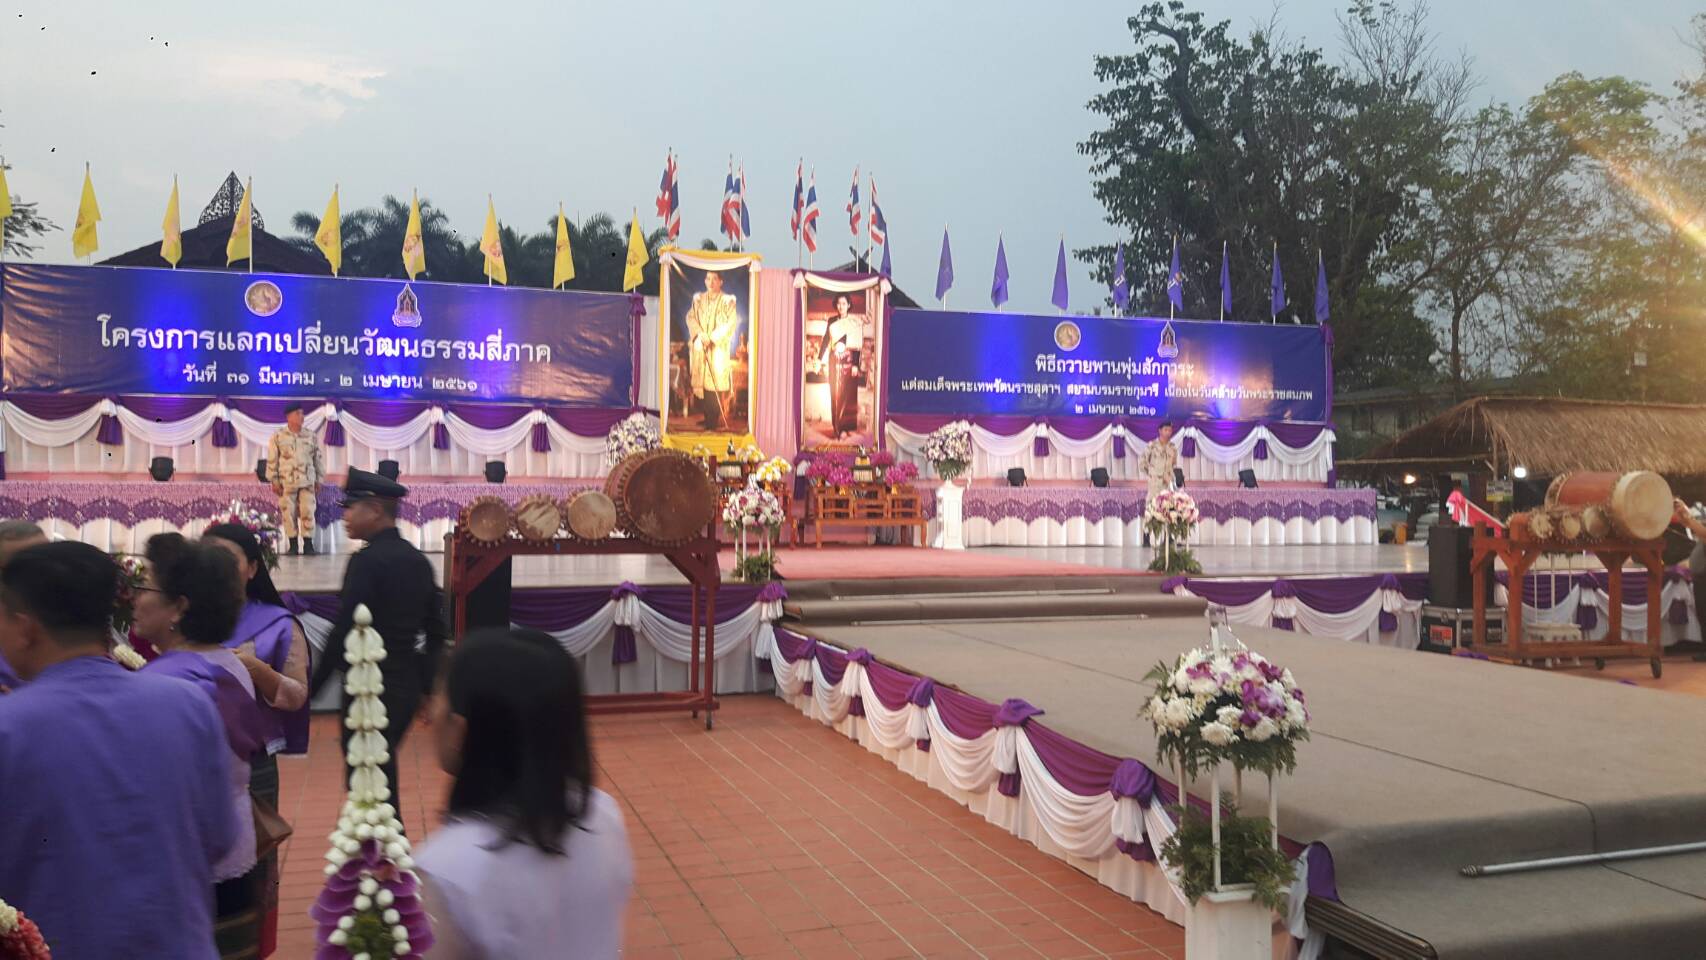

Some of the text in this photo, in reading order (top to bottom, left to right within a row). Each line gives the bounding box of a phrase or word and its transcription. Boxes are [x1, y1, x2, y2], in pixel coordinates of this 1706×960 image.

[96, 313, 552, 363] โครงการแลกเปลี่ยนวัฒนธรรมสี่ภาค
[182, 360, 218, 383] วันที่
[227, 372, 250, 385] ๓๑
[258, 366, 315, 386] มีนาคม
[339, 373, 353, 387] ๒
[362, 374, 423, 389] เมษายน
[432, 376, 478, 392] ๒๕๖๑
[1035, 353, 1195, 380] พิธีถวายพานพุ่มสักการะ
[1088, 404, 1125, 415] เมษายน
